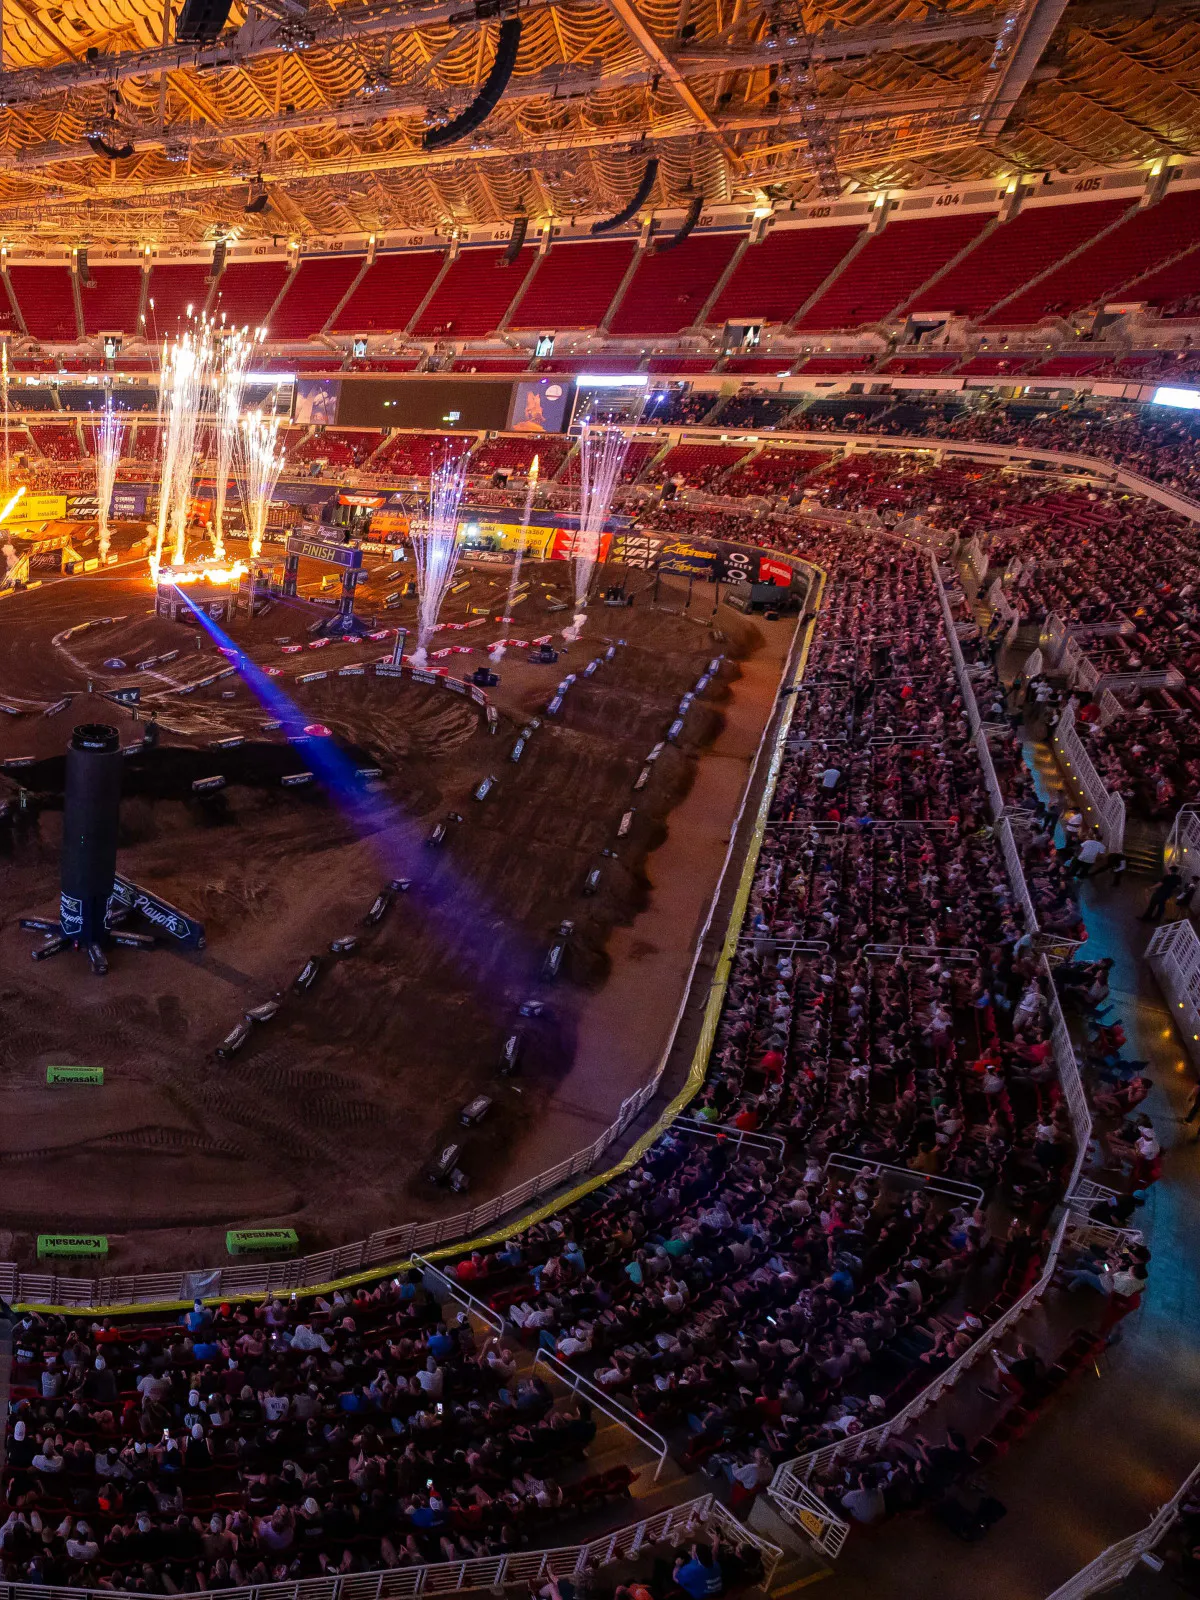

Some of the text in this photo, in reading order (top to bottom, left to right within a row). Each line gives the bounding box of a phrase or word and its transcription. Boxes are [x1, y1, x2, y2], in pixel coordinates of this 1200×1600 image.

[1074, 177, 1103, 193] 405
[935, 193, 960, 207] 404
[808, 206, 831, 219] 403
[494, 230, 510, 240] 454
[329, 242, 343, 251] 452
[407, 236, 423, 246] 453
[624, 537, 662, 548] UFO
[302, 544, 336, 560] FINISH
[724, 560, 753, 571] OAKLEY
[60, 906, 84, 925] Playoffs
[133, 894, 178, 932] Playoffs
[53, 1074, 98, 1083] Kawasaki
[236, 1231, 291, 1240] Kawasaki
[45, 1238, 101, 1248] Kawasaki
